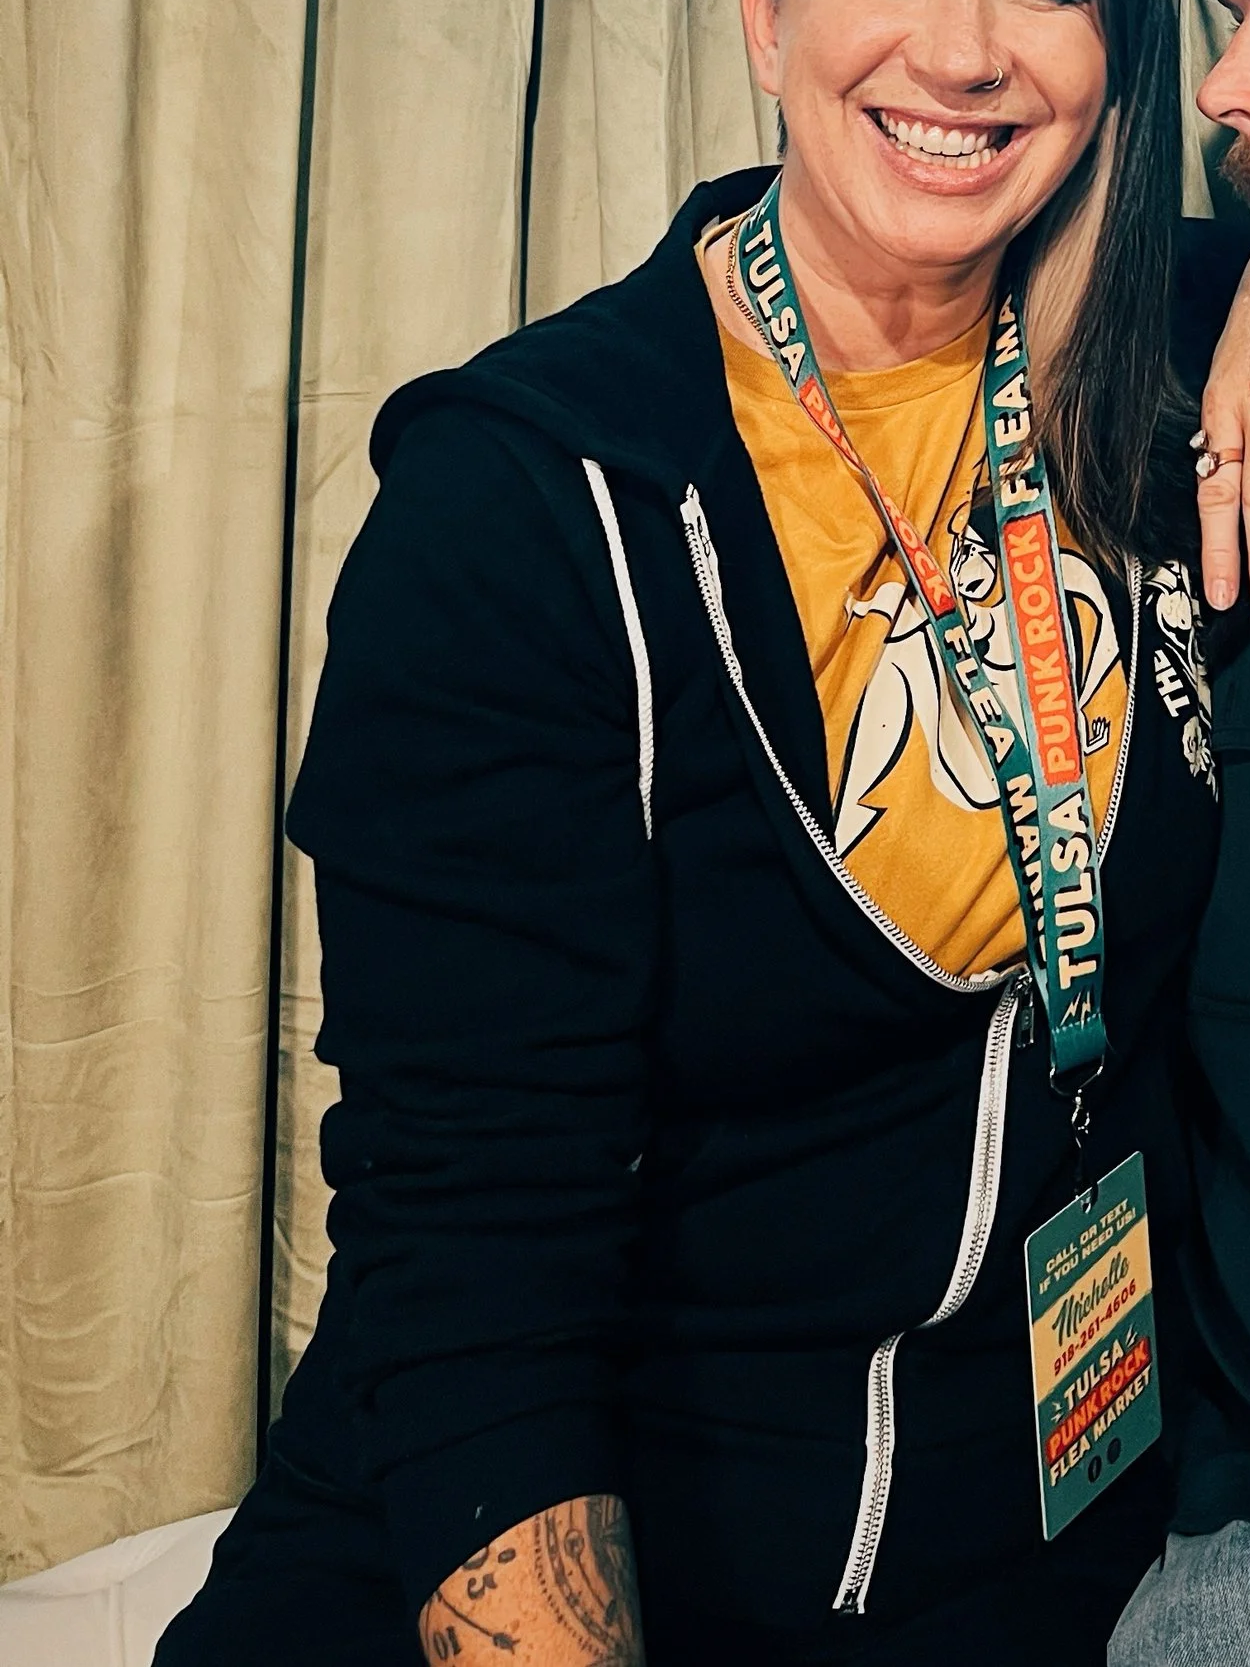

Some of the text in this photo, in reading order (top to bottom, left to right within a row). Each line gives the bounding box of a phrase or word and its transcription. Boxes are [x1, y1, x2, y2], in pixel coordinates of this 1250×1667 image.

[743, 219, 806, 381] TULSA
[944, 625, 1015, 763] FLEA
[992, 372, 1040, 508] FLEA
[1009, 524, 1057, 646] ROCK
[1030, 649, 1076, 774] PUNK
[1048, 792, 1097, 990] TULSA
[1040, 1275, 1051, 1294] IF
[1054, 1254, 1079, 1281] YOU
[1082, 1228, 1114, 1260] NEED
[1046, 1198, 1128, 1273] CALL OR TEXT
[1051, 1250, 1129, 1347] Michelle
[1053, 1278, 1136, 1376] 918-261-4606
[1050, 1364, 1152, 1487] FLEA MARKET
[1064, 1338, 1125, 1411] TULSA
